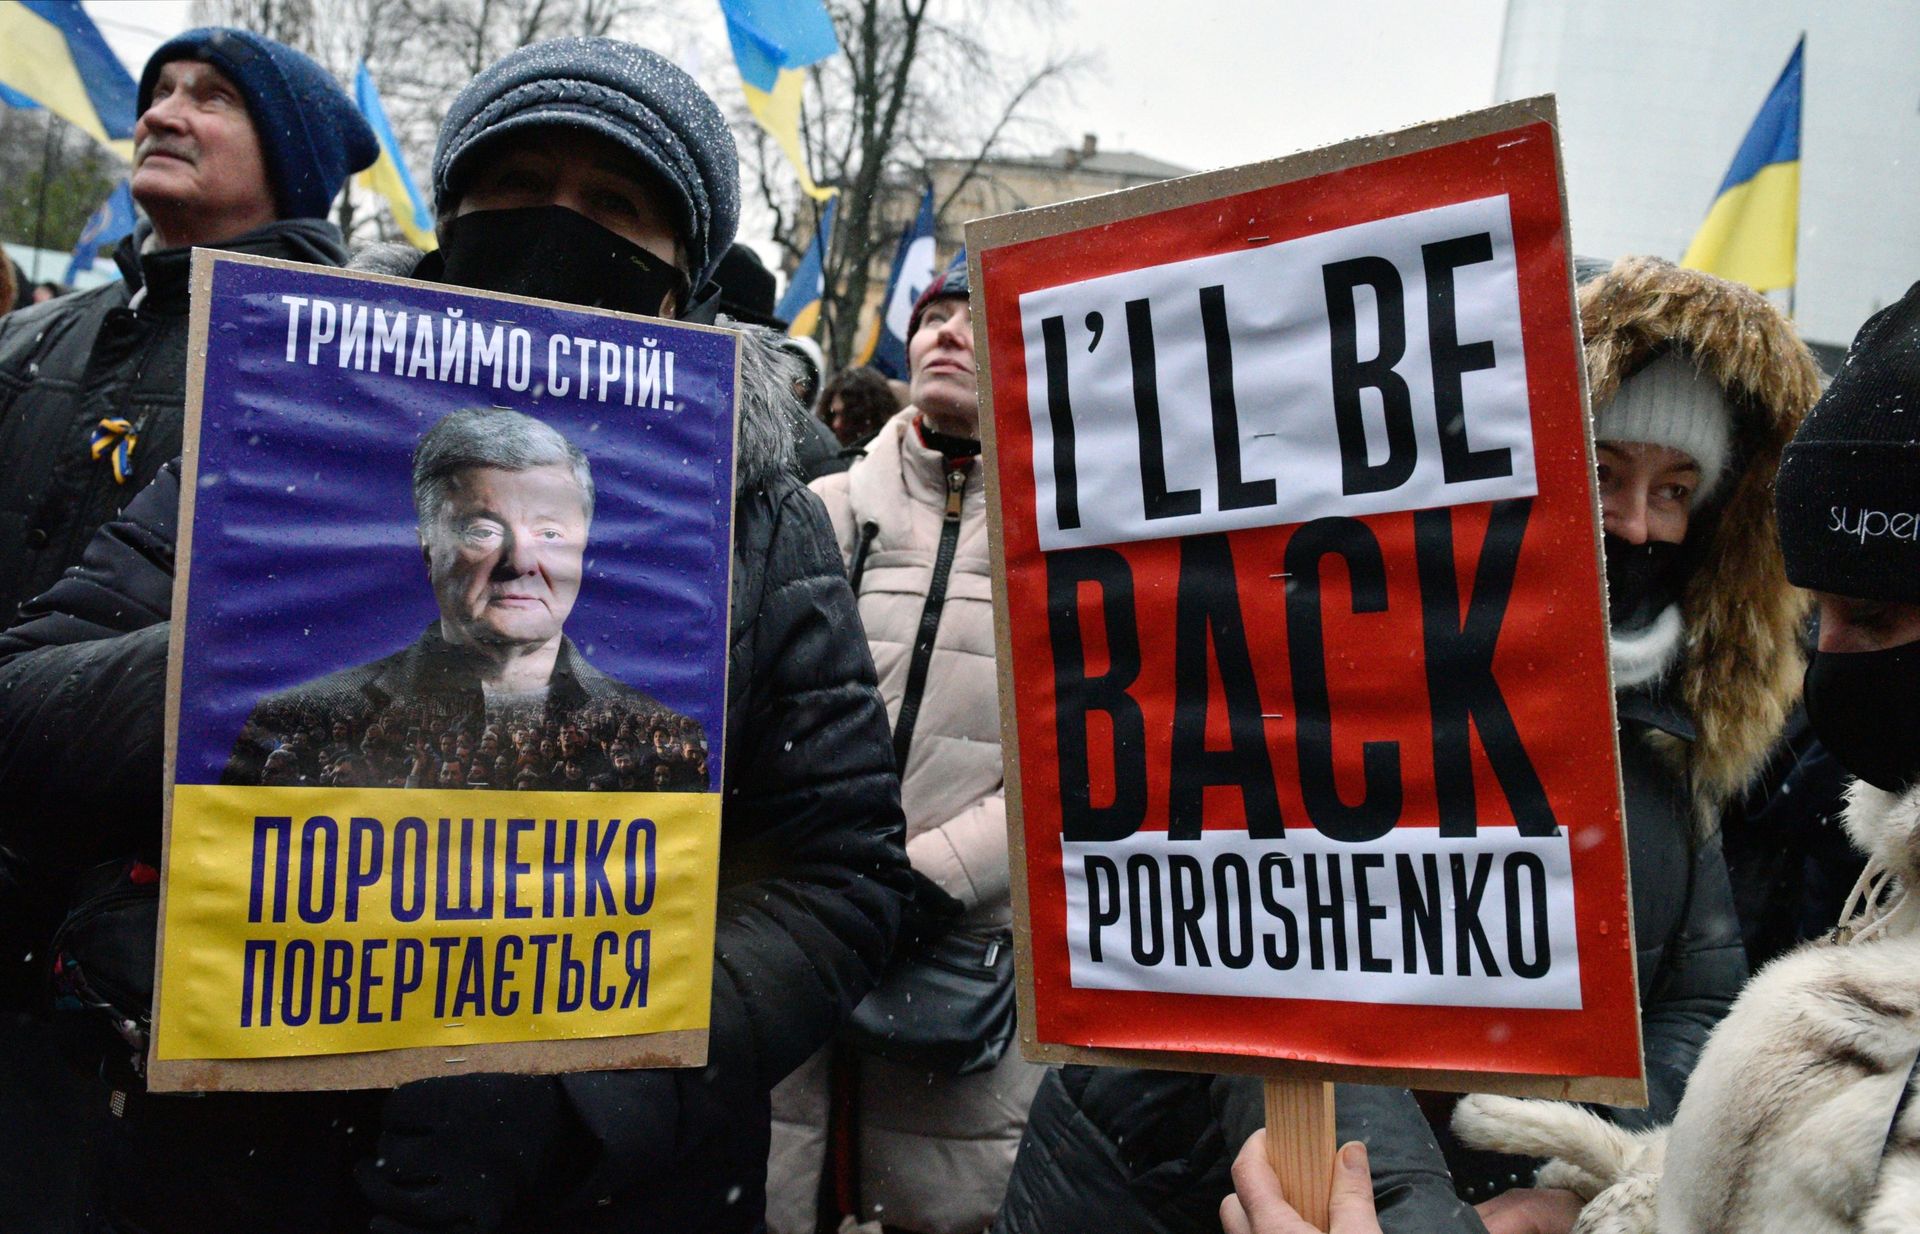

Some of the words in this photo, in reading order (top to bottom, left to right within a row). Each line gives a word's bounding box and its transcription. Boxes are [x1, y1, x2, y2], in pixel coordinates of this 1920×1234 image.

[281, 295, 532, 392] ТРИМАЙМО
[547, 333, 675, 411] СТРІЙ!
[1322, 232, 1513, 496] BE
[1045, 496, 1563, 842] BACK
[248, 816, 657, 924] ПОРОШЕНКО
[1083, 851, 1552, 979] POROSHENKO
[240, 929, 651, 1028] ПОВЕРТАЄТЬСЯ
